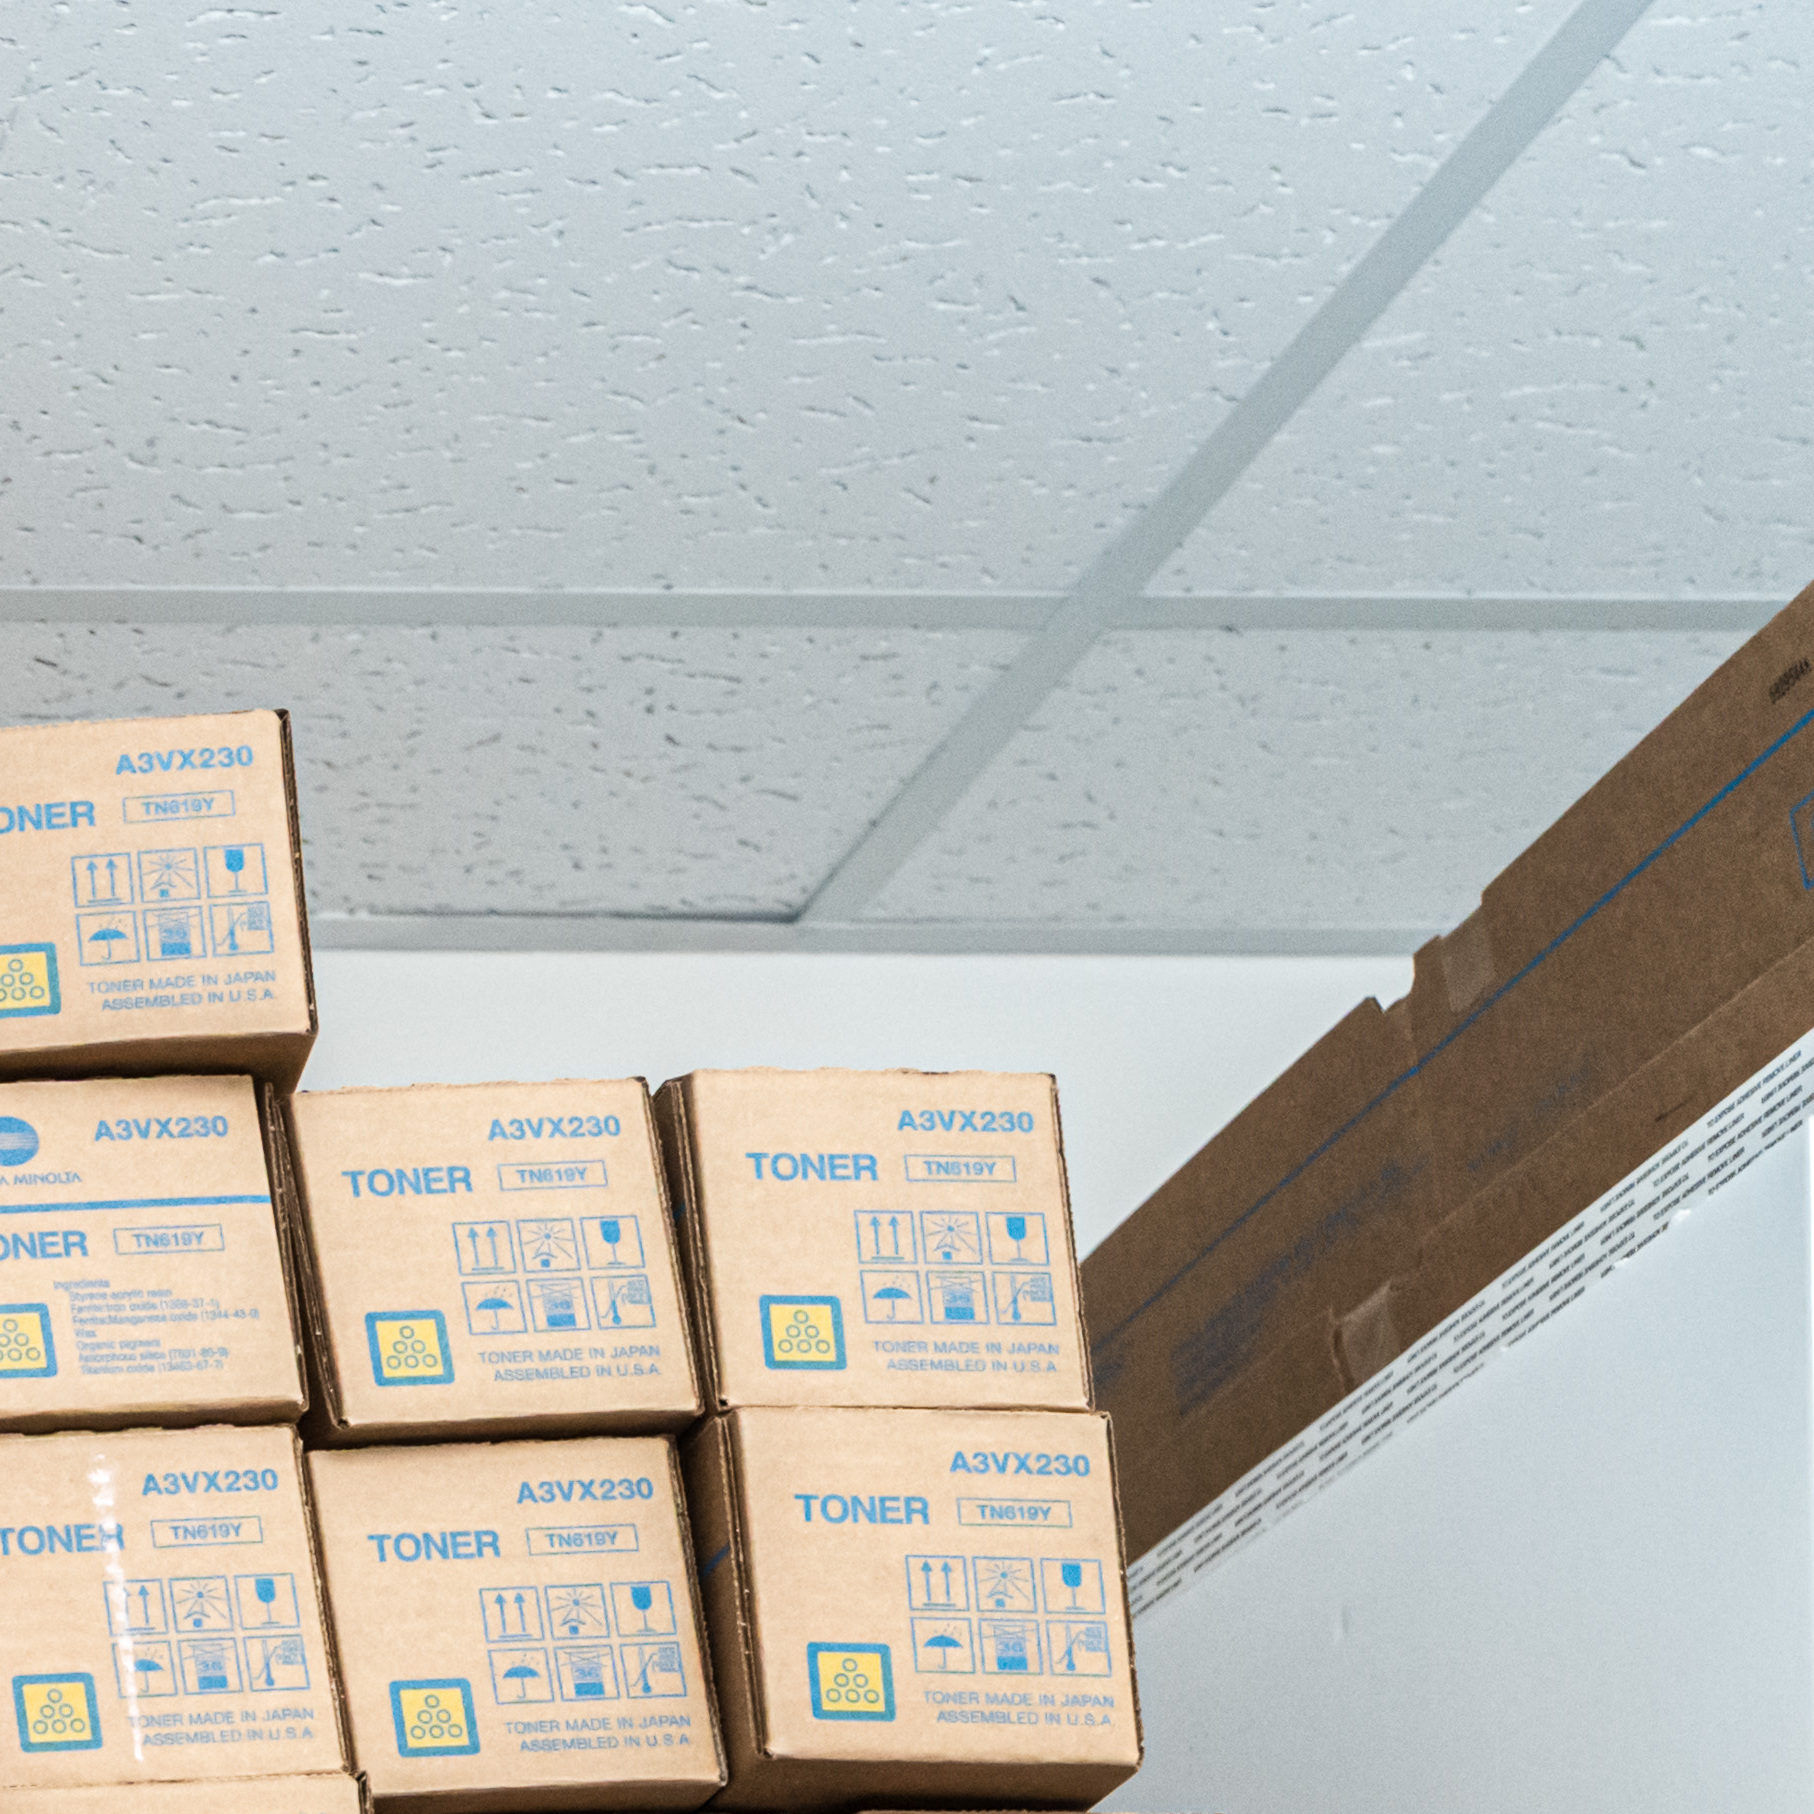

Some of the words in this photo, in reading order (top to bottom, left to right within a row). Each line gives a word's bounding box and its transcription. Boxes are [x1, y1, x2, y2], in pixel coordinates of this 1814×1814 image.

[117, 748, 253, 776] A3VX230
[899, 1111, 1034, 1133] A3VX230
[746, 1154, 879, 1182] TONER
[951, 1452, 1091, 1478] A3VX230
[795, 1495, 930, 1526] TONER
[974, 1502, 1053, 1523] TN619Y
